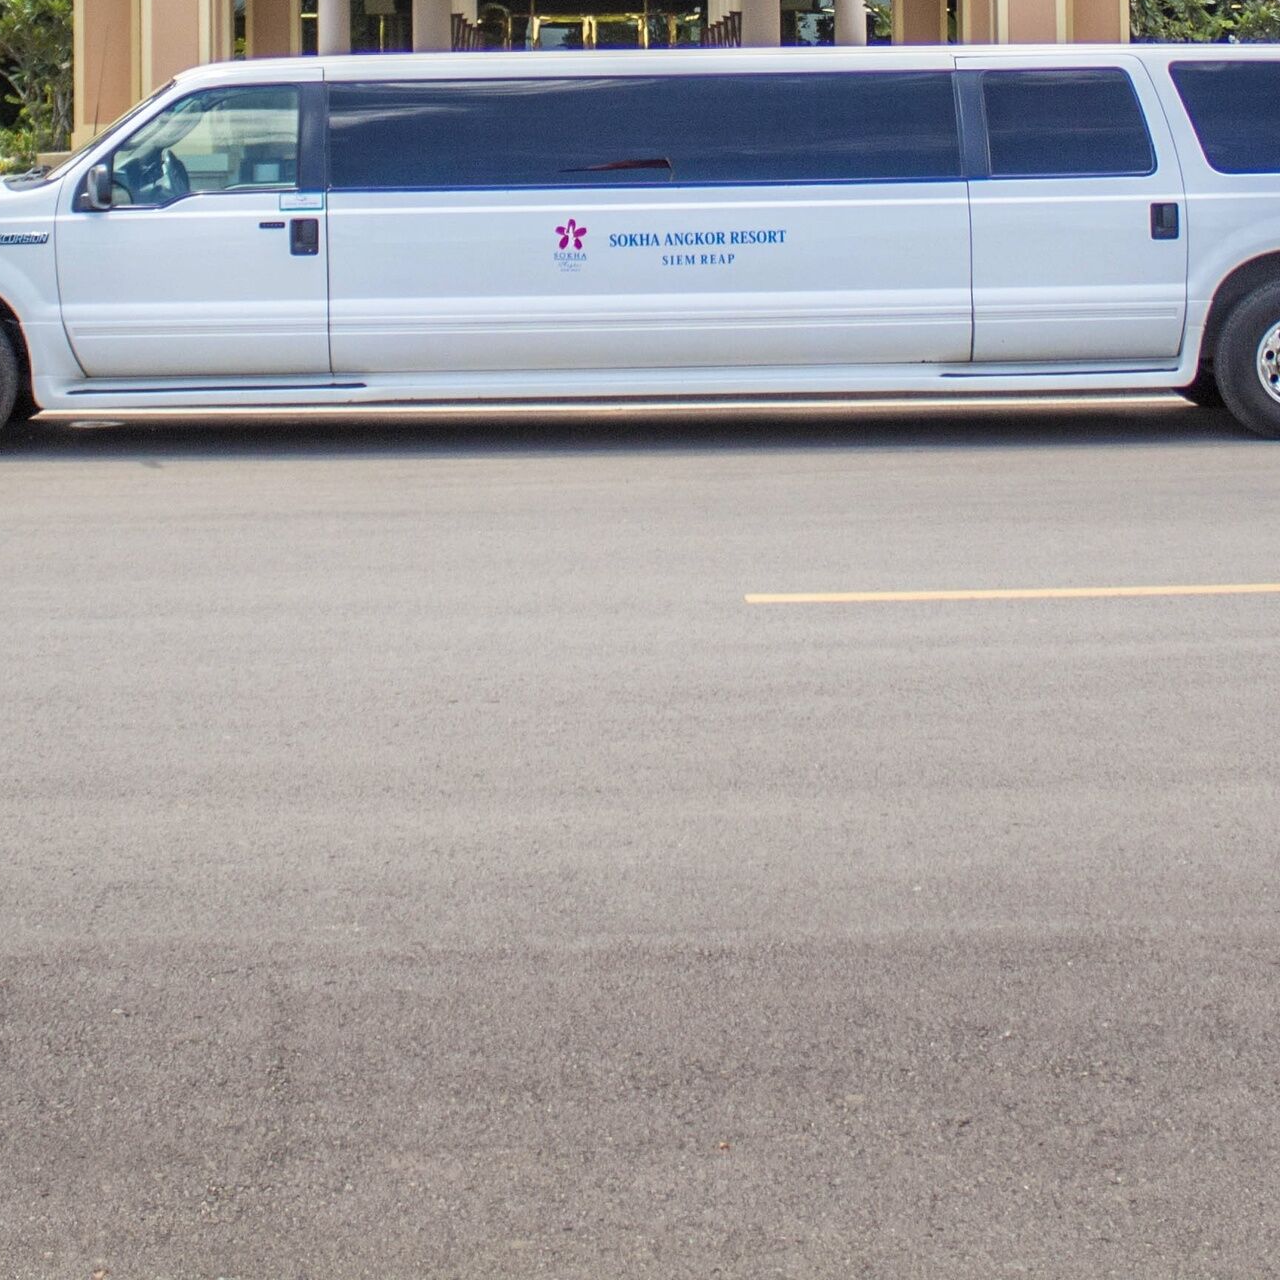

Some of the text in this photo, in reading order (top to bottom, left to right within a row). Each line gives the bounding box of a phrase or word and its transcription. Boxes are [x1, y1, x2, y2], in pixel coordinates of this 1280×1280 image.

[609, 229, 787, 248] SOKHA ANGKOR RESORT
[553, 252, 587, 261] SOKHA
[662, 253, 736, 266] SIEM REAP
